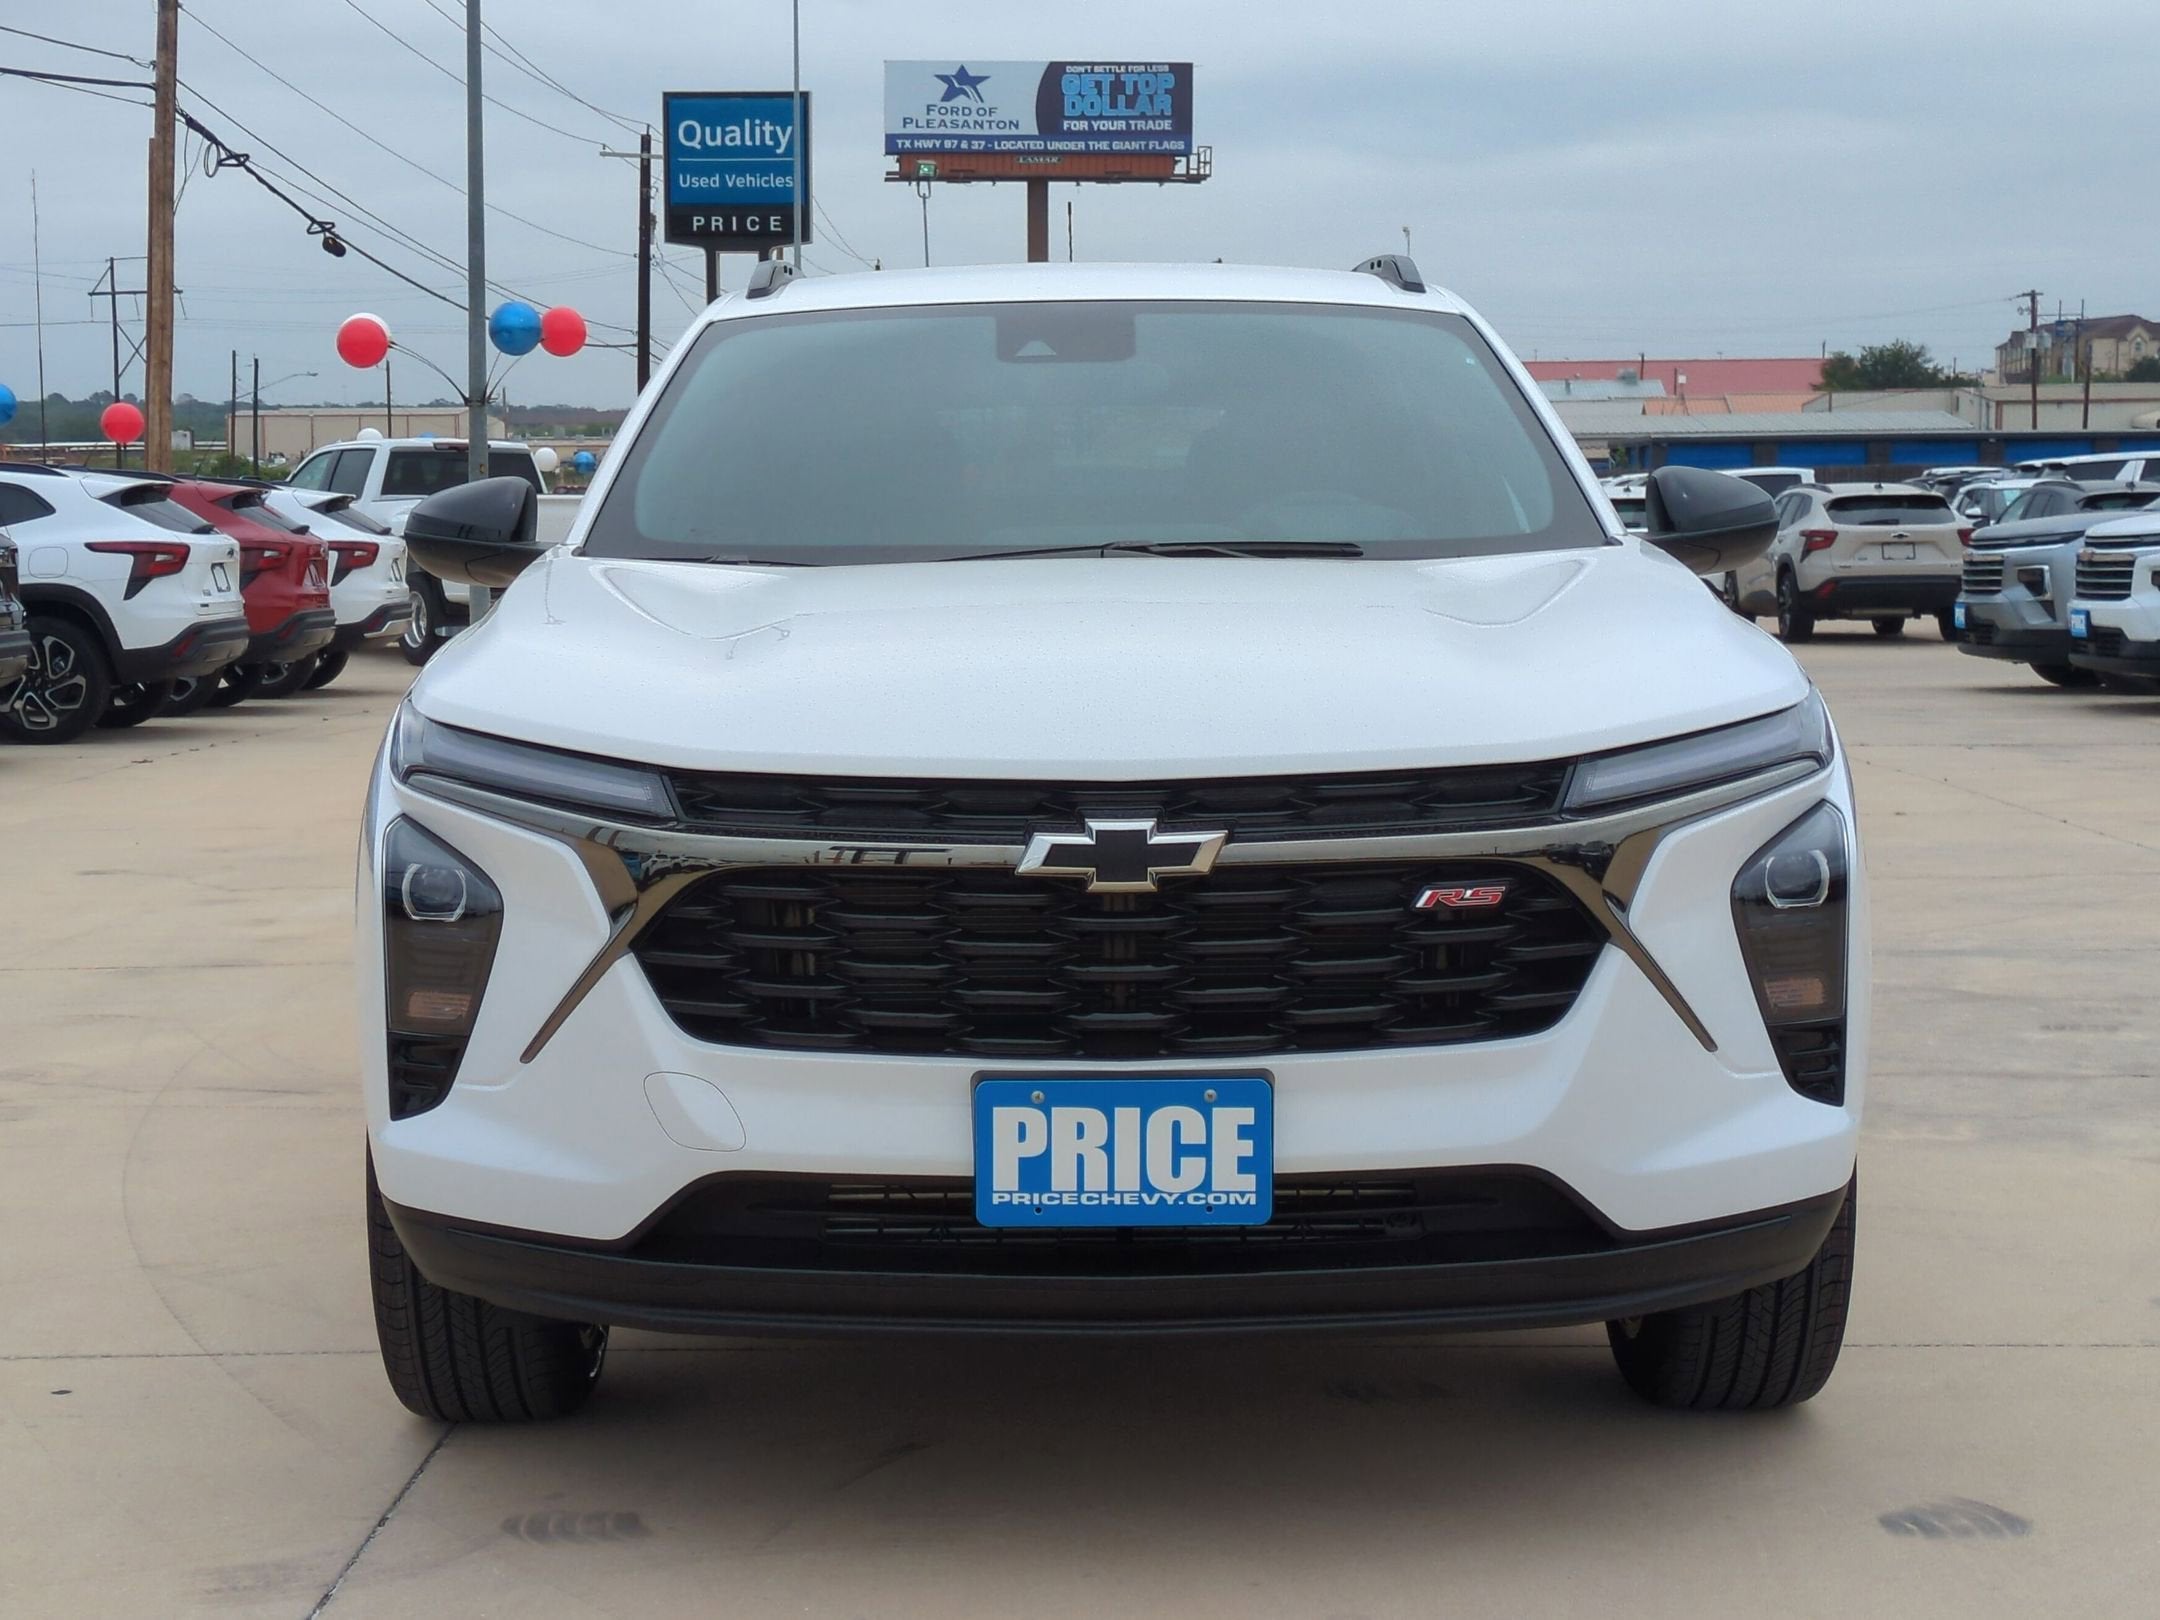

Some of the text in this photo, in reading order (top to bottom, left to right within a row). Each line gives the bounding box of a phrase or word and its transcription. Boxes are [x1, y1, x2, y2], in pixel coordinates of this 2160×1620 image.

[1128, 65, 1145, 73] FOR
[1061, 73, 1175, 95] GET TOP
[926, 104, 998, 117] FORD OF
[1064, 94, 1172, 116] DOLLAR
[902, 117, 1019, 130] PLEASANTON
[1063, 120, 1172, 131] FOR YOUR TRADE
[678, 118, 793, 154] Quality
[896, 140, 912, 149] TX
[914, 140, 941, 149] HWY
[970, 141, 986, 150] 37
[994, 141, 1043, 150] LOCATED
[1047, 141, 1085, 150] UNDER
[1089, 141, 1110, 150] THE
[1112, 141, 1147, 150] GIANT
[1149, 141, 1184, 150] FLAGS
[679, 173, 793, 188] Used Vehicles
[693, 216, 782, 231] PRICE
[1415, 886, 1506, 908] RS
[992, 1105, 1256, 1193] PRICE
[992, 1192, 1257, 1206] PRICECHEVY.COM
